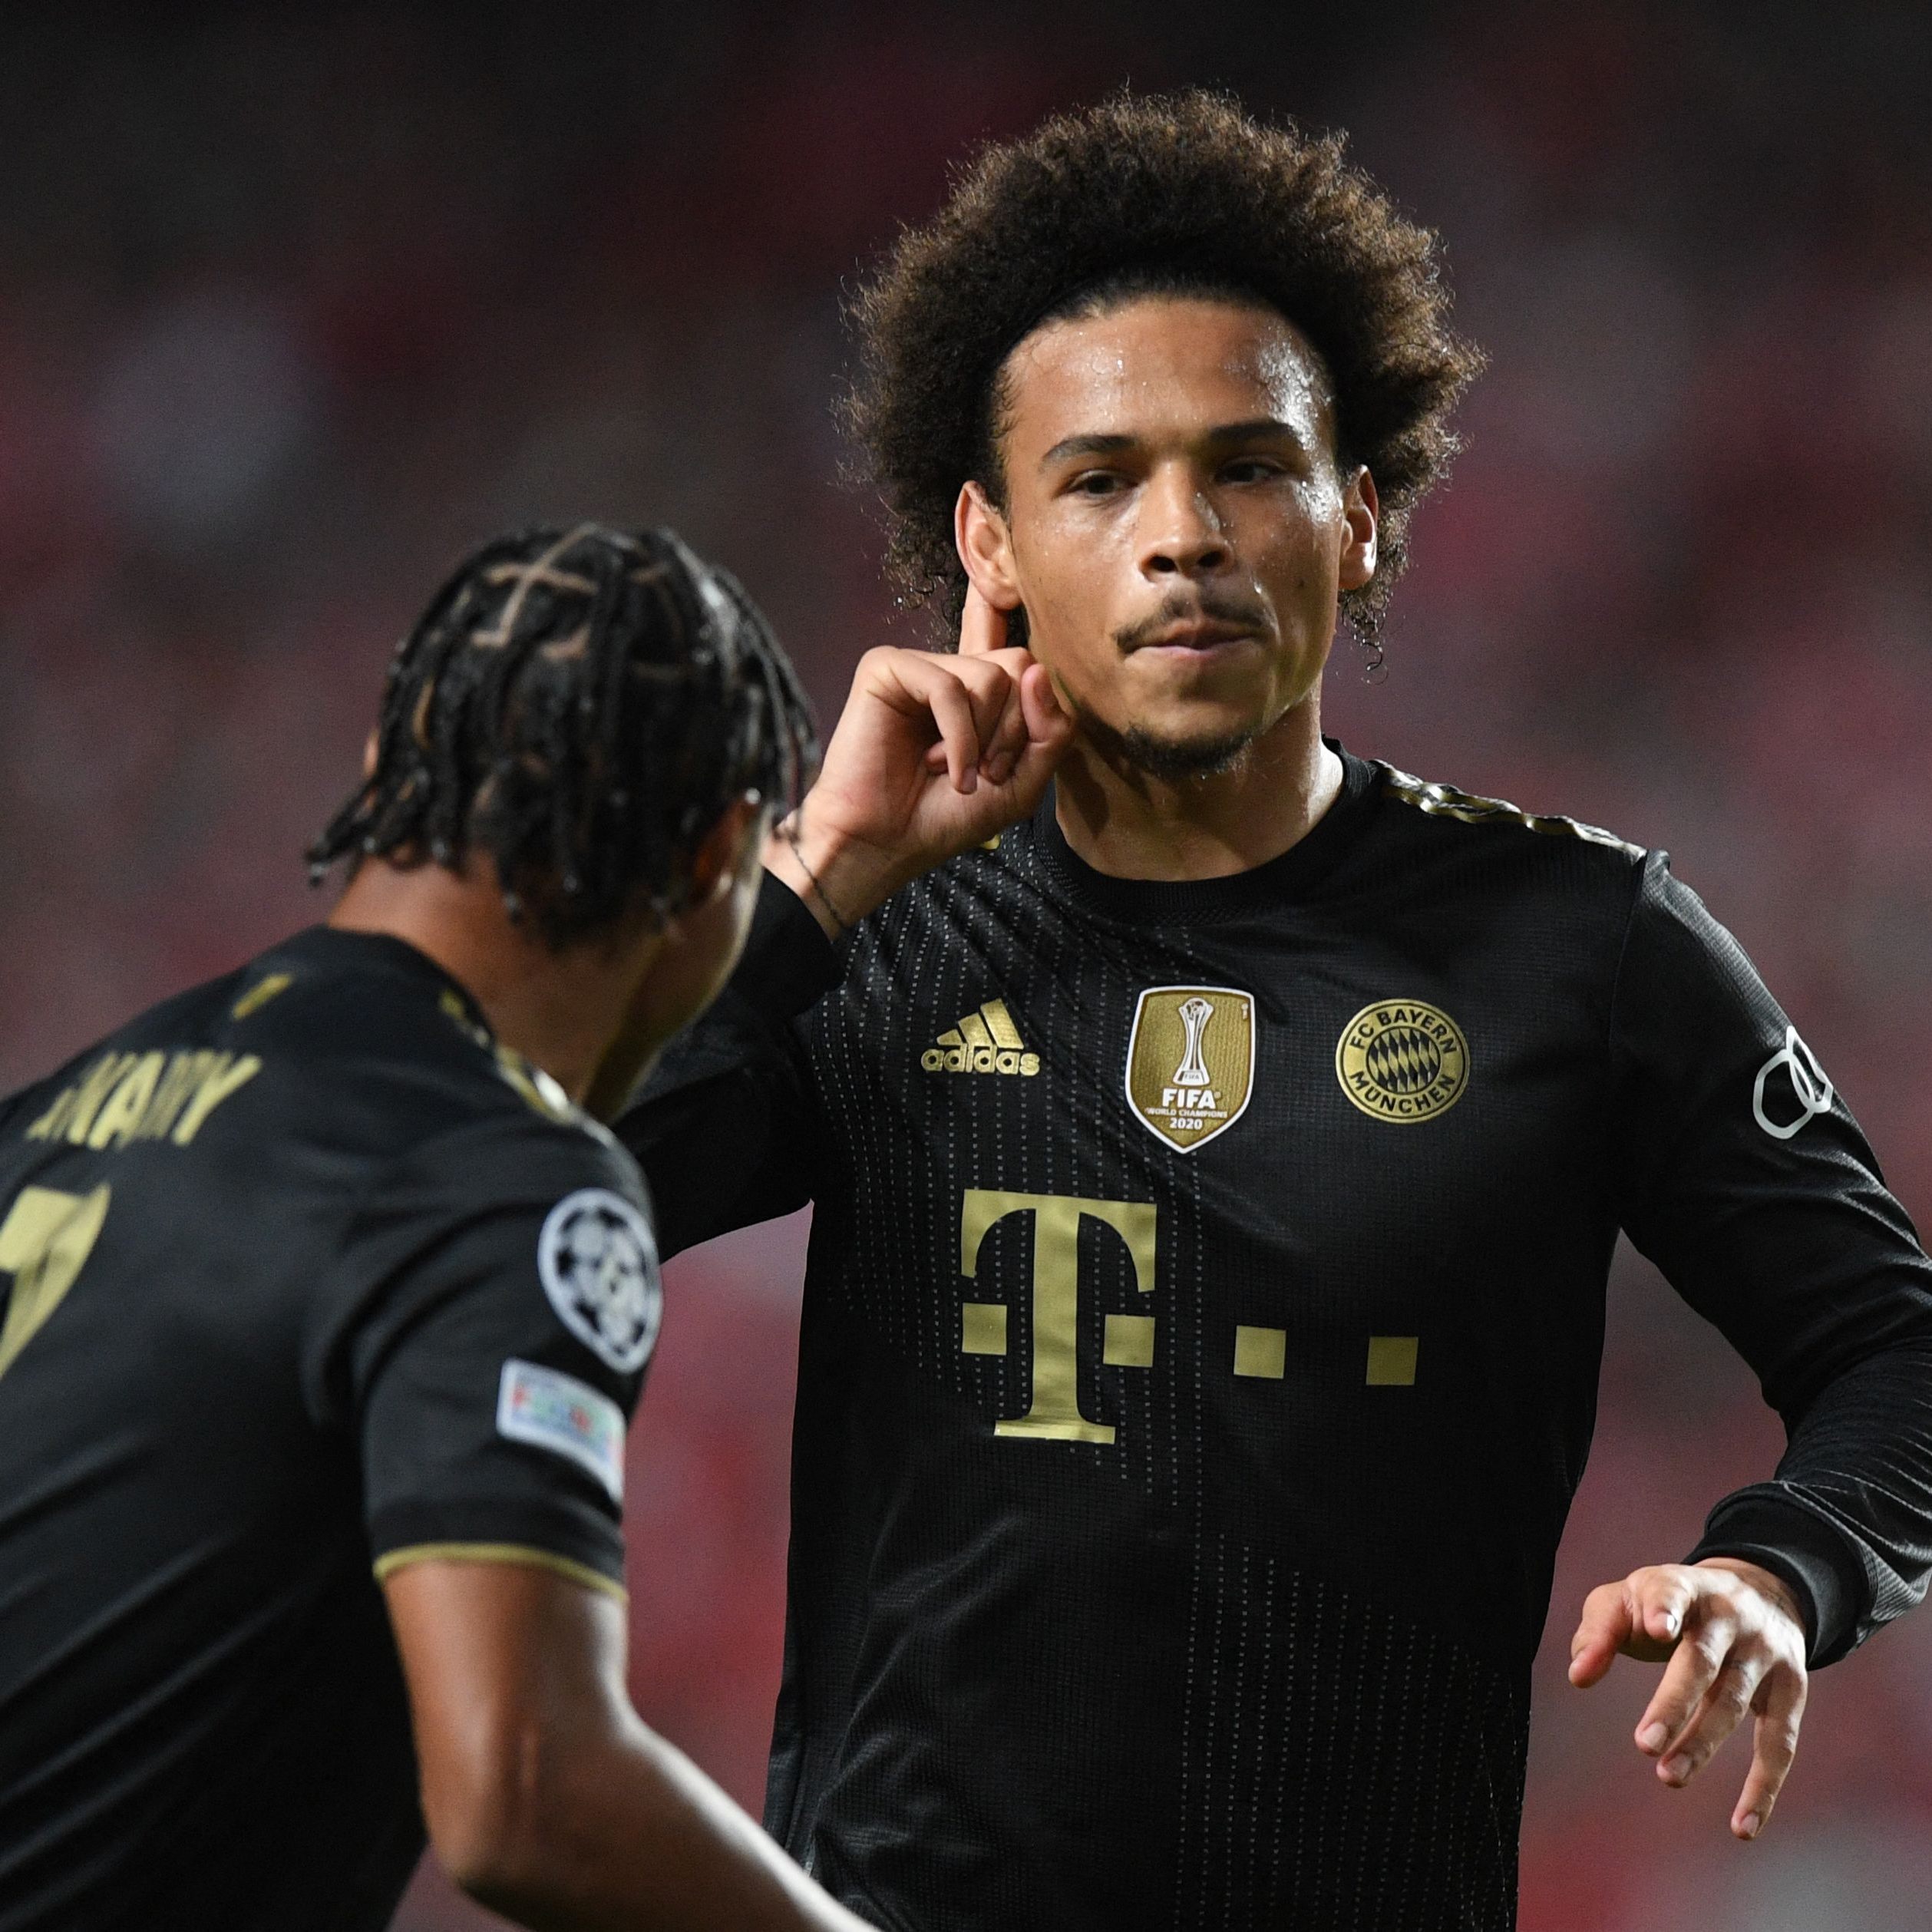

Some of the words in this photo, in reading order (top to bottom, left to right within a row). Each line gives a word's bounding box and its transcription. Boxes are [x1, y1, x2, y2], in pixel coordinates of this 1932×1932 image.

[1349, 1023, 1374, 1050] FC
[1376, 1009, 1457, 1054] BAYERN
[921, 1043, 1040, 1076] adidas
[1161, 1088, 1216, 1109] FIFA
[1349, 1071, 1455, 1113] MÜNCHEN
[1145, 1107, 1177, 1116] WORLD
[1169, 1118, 1203, 1130] 2020
[960, 1189, 1157, 1445] T
